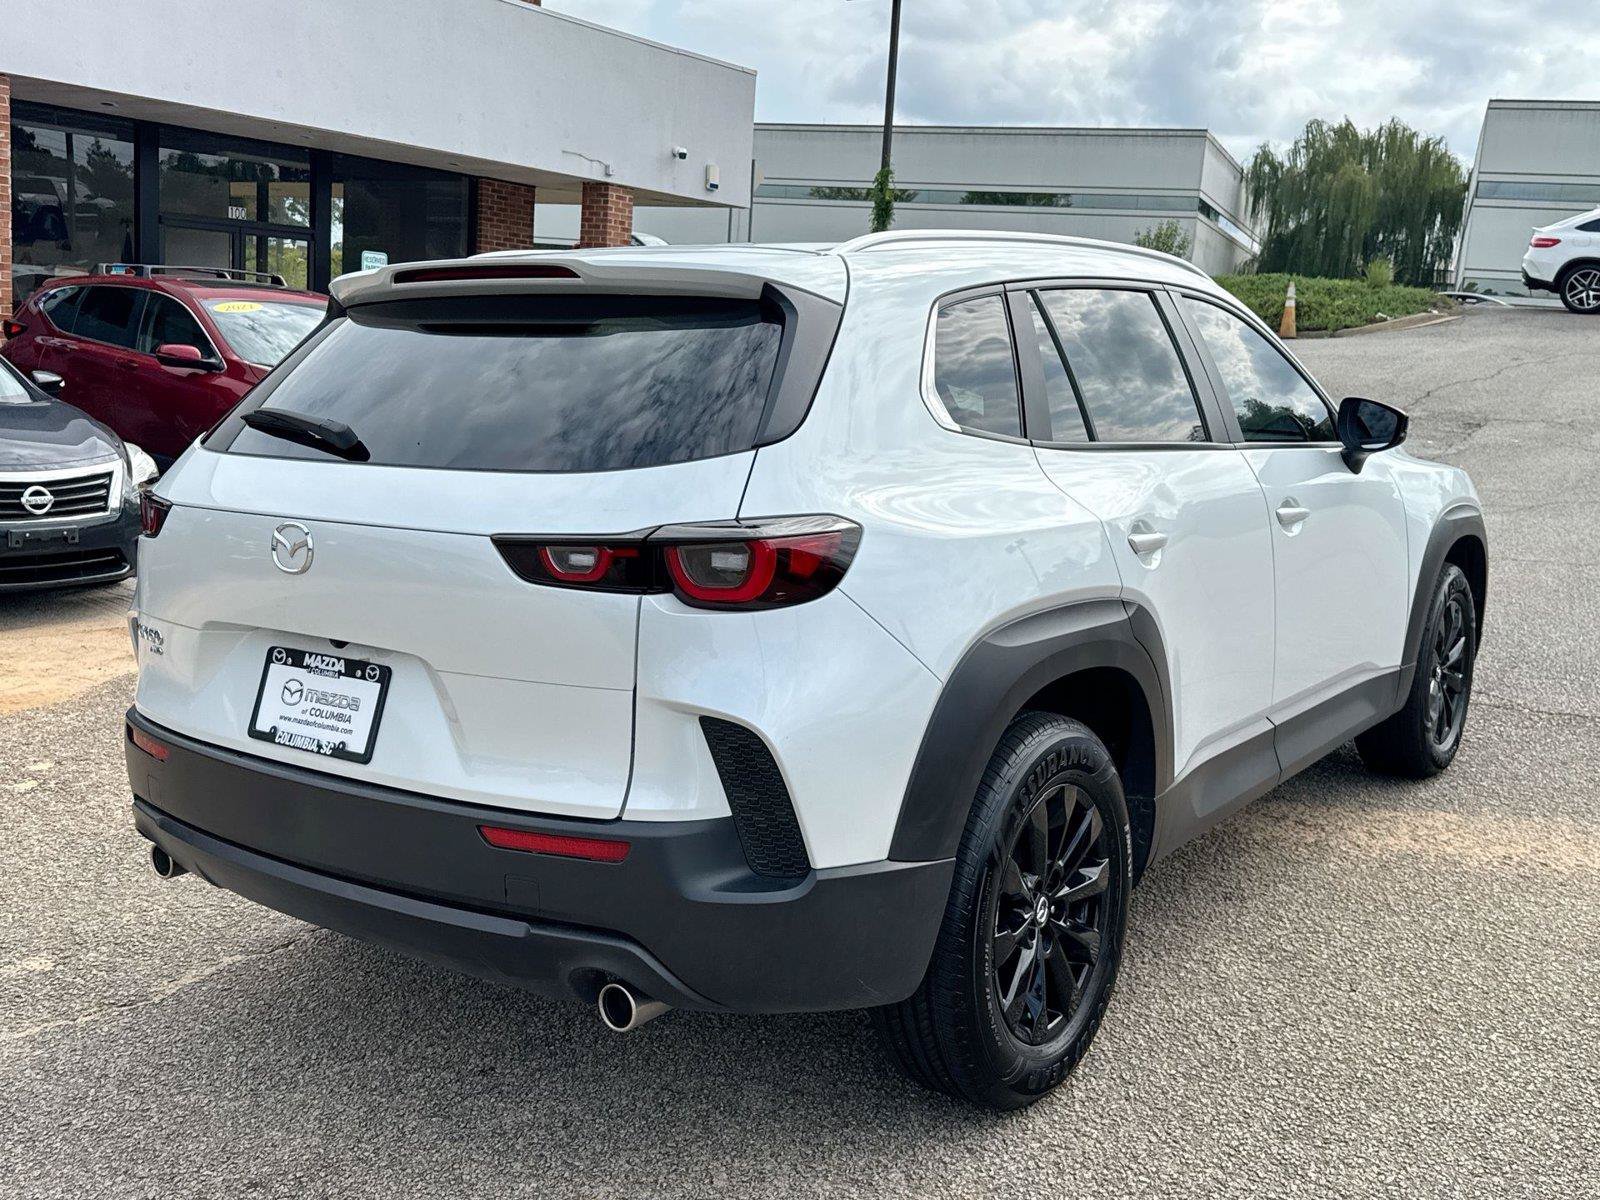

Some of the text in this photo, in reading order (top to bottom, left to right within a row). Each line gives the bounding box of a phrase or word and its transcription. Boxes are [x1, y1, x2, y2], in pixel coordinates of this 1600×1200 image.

[230, 206, 246, 219] 100
[303, 653, 345, 673] MAZDA
[304, 688, 361, 712] mazda
[279, 714, 354, 736] www.mazdaofcolumbia.com
[301, 707, 352, 725] of COLUMBIA
[320, 742, 335, 755] SC
